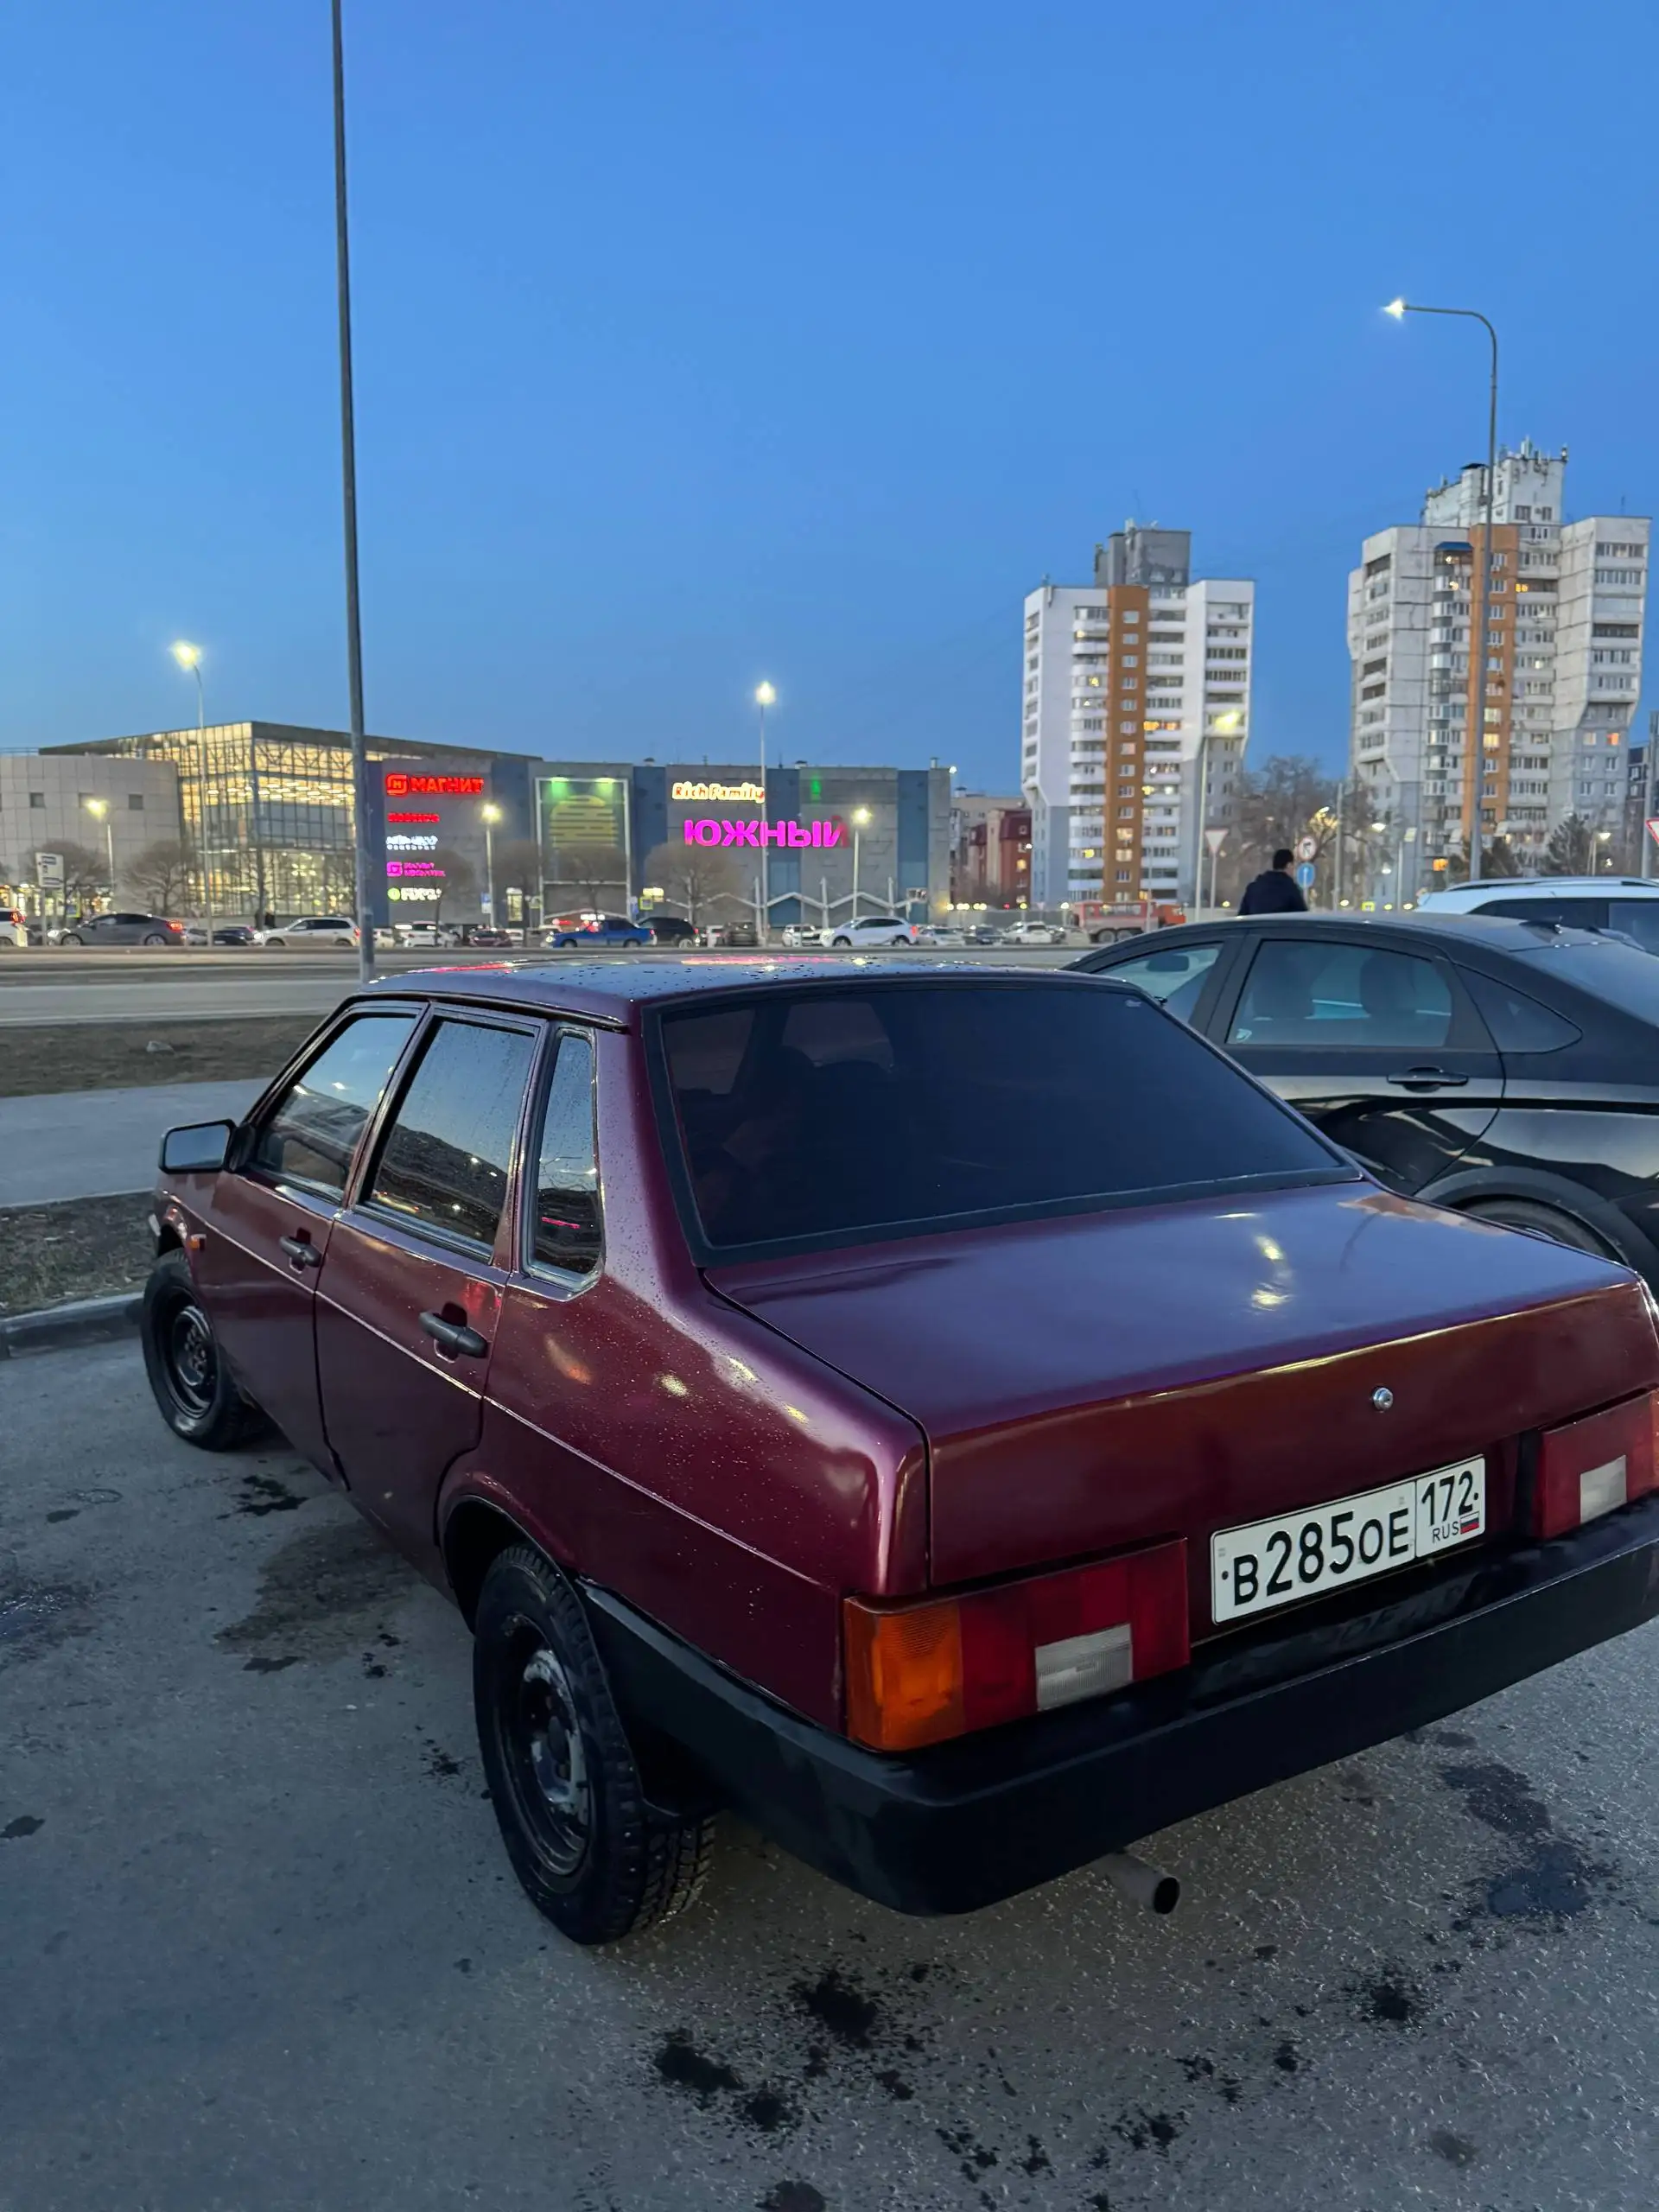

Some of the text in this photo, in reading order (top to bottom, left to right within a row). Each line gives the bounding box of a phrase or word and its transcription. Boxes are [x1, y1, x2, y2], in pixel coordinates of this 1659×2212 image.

[410, 776, 484, 793] МАГНИТ
[672, 781, 765, 804] Rich Family
[683, 815, 849, 849] ЮЖНЫЙ
[1421, 1471, 1474, 1527] 172
[1432, 1520, 1460, 1544] RUS
